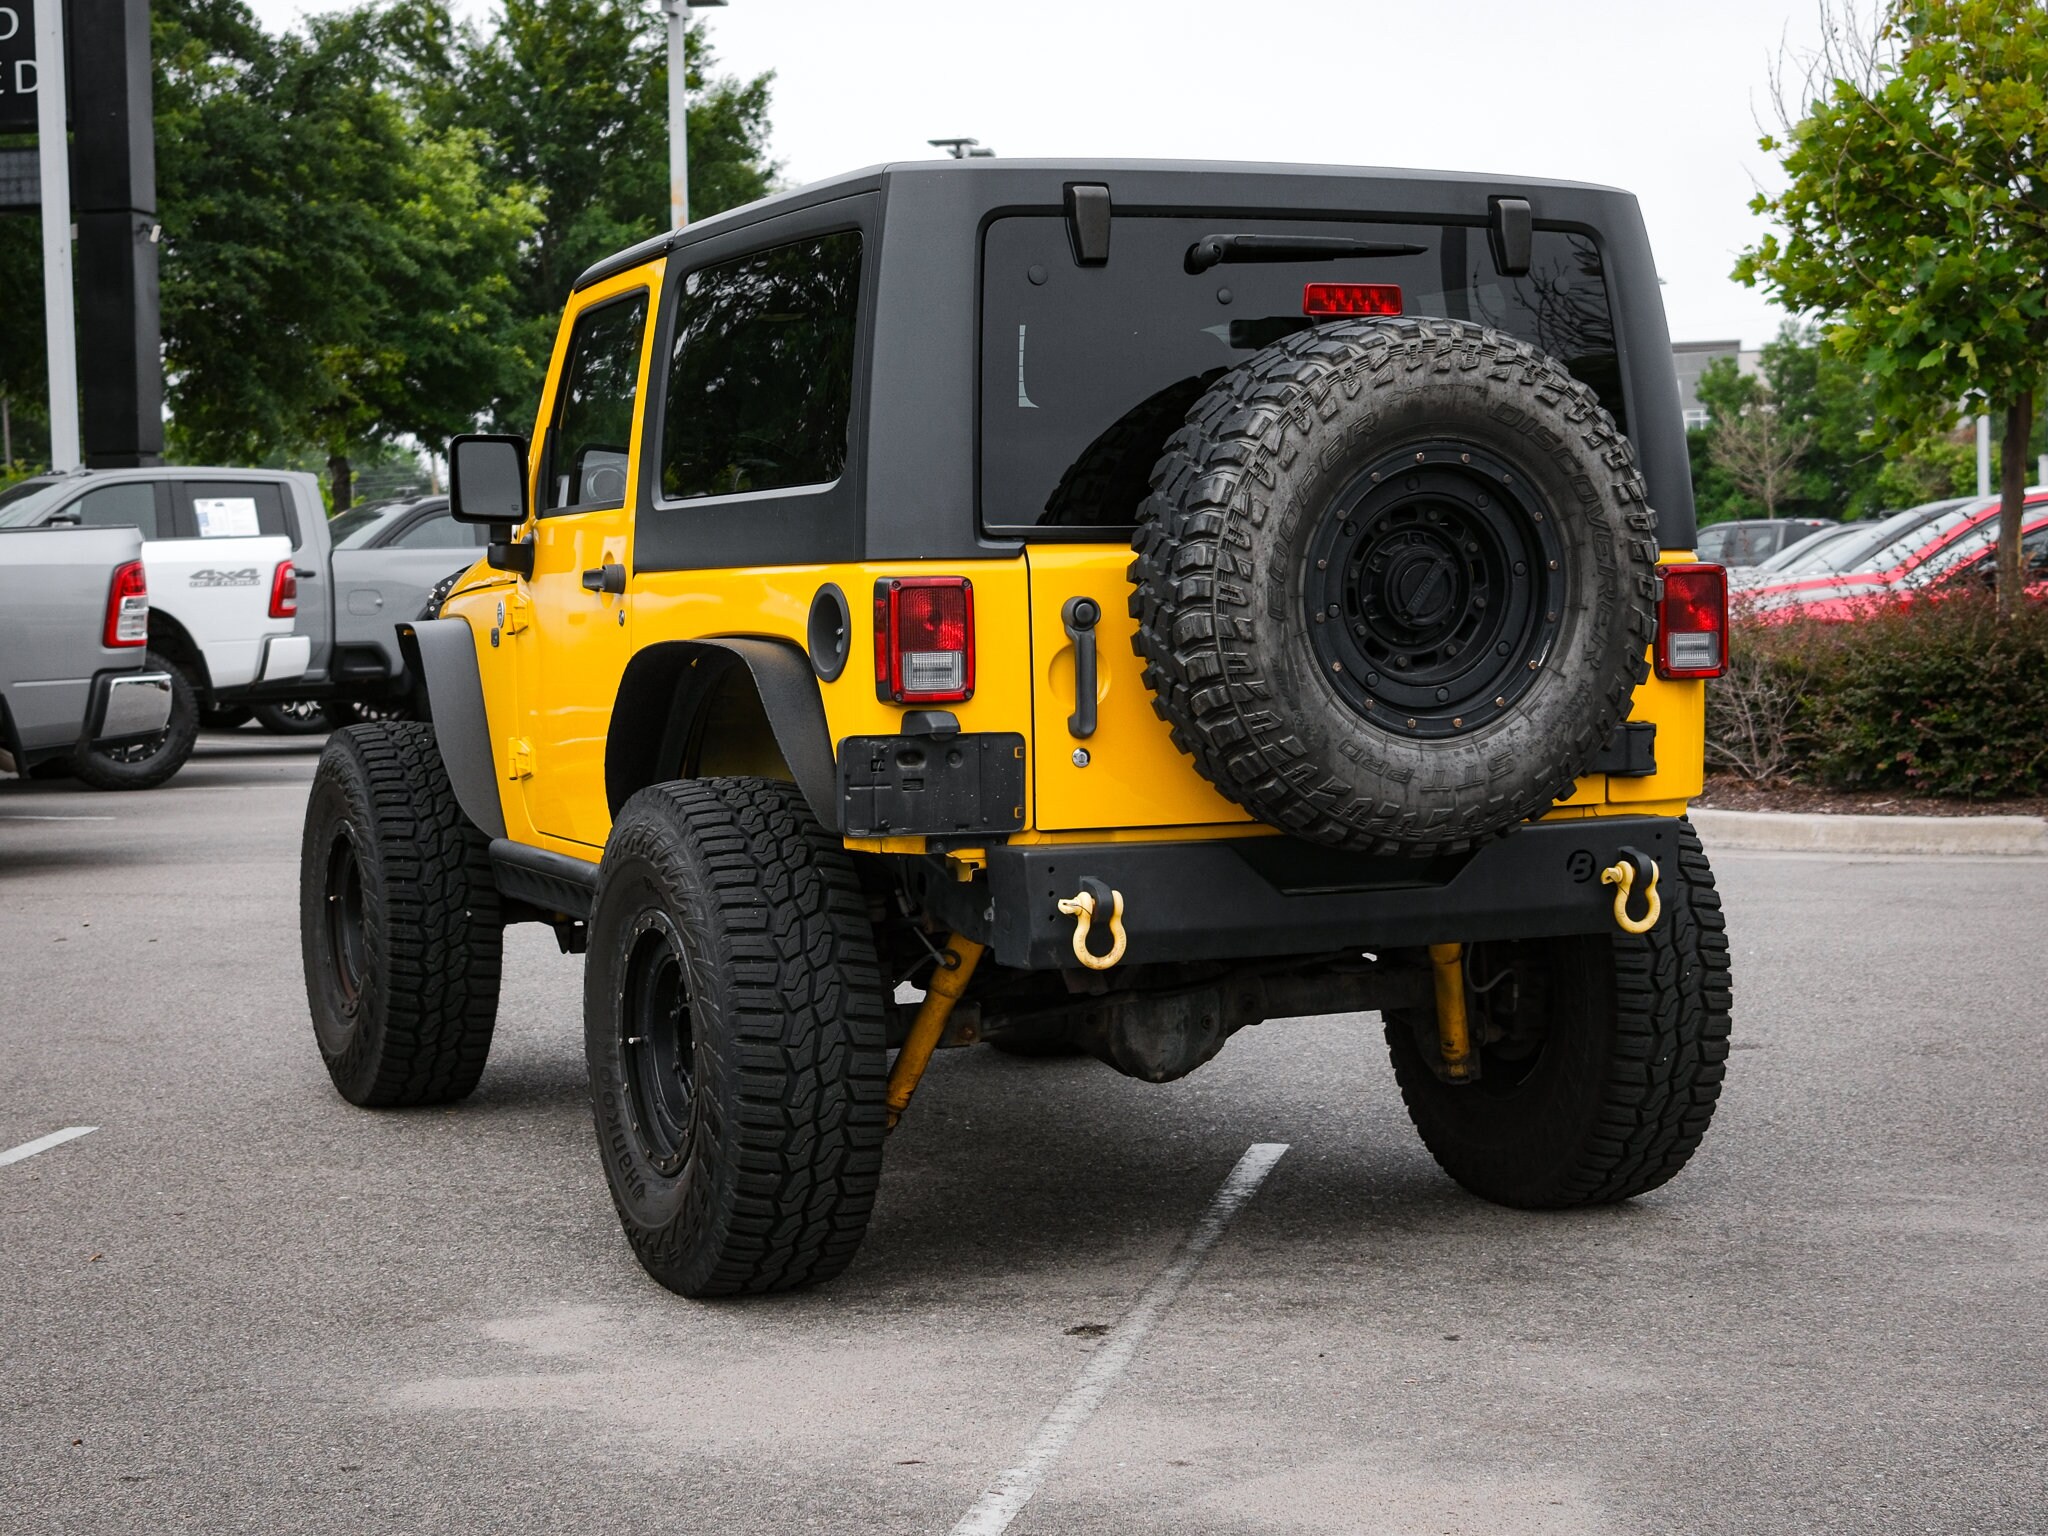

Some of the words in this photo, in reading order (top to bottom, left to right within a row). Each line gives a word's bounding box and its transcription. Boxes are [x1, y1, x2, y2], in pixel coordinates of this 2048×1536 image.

[1487, 402, 1617, 671] DISCOVERER
[1338, 738, 1416, 784] PRO
[1420, 750, 1516, 792] STT
